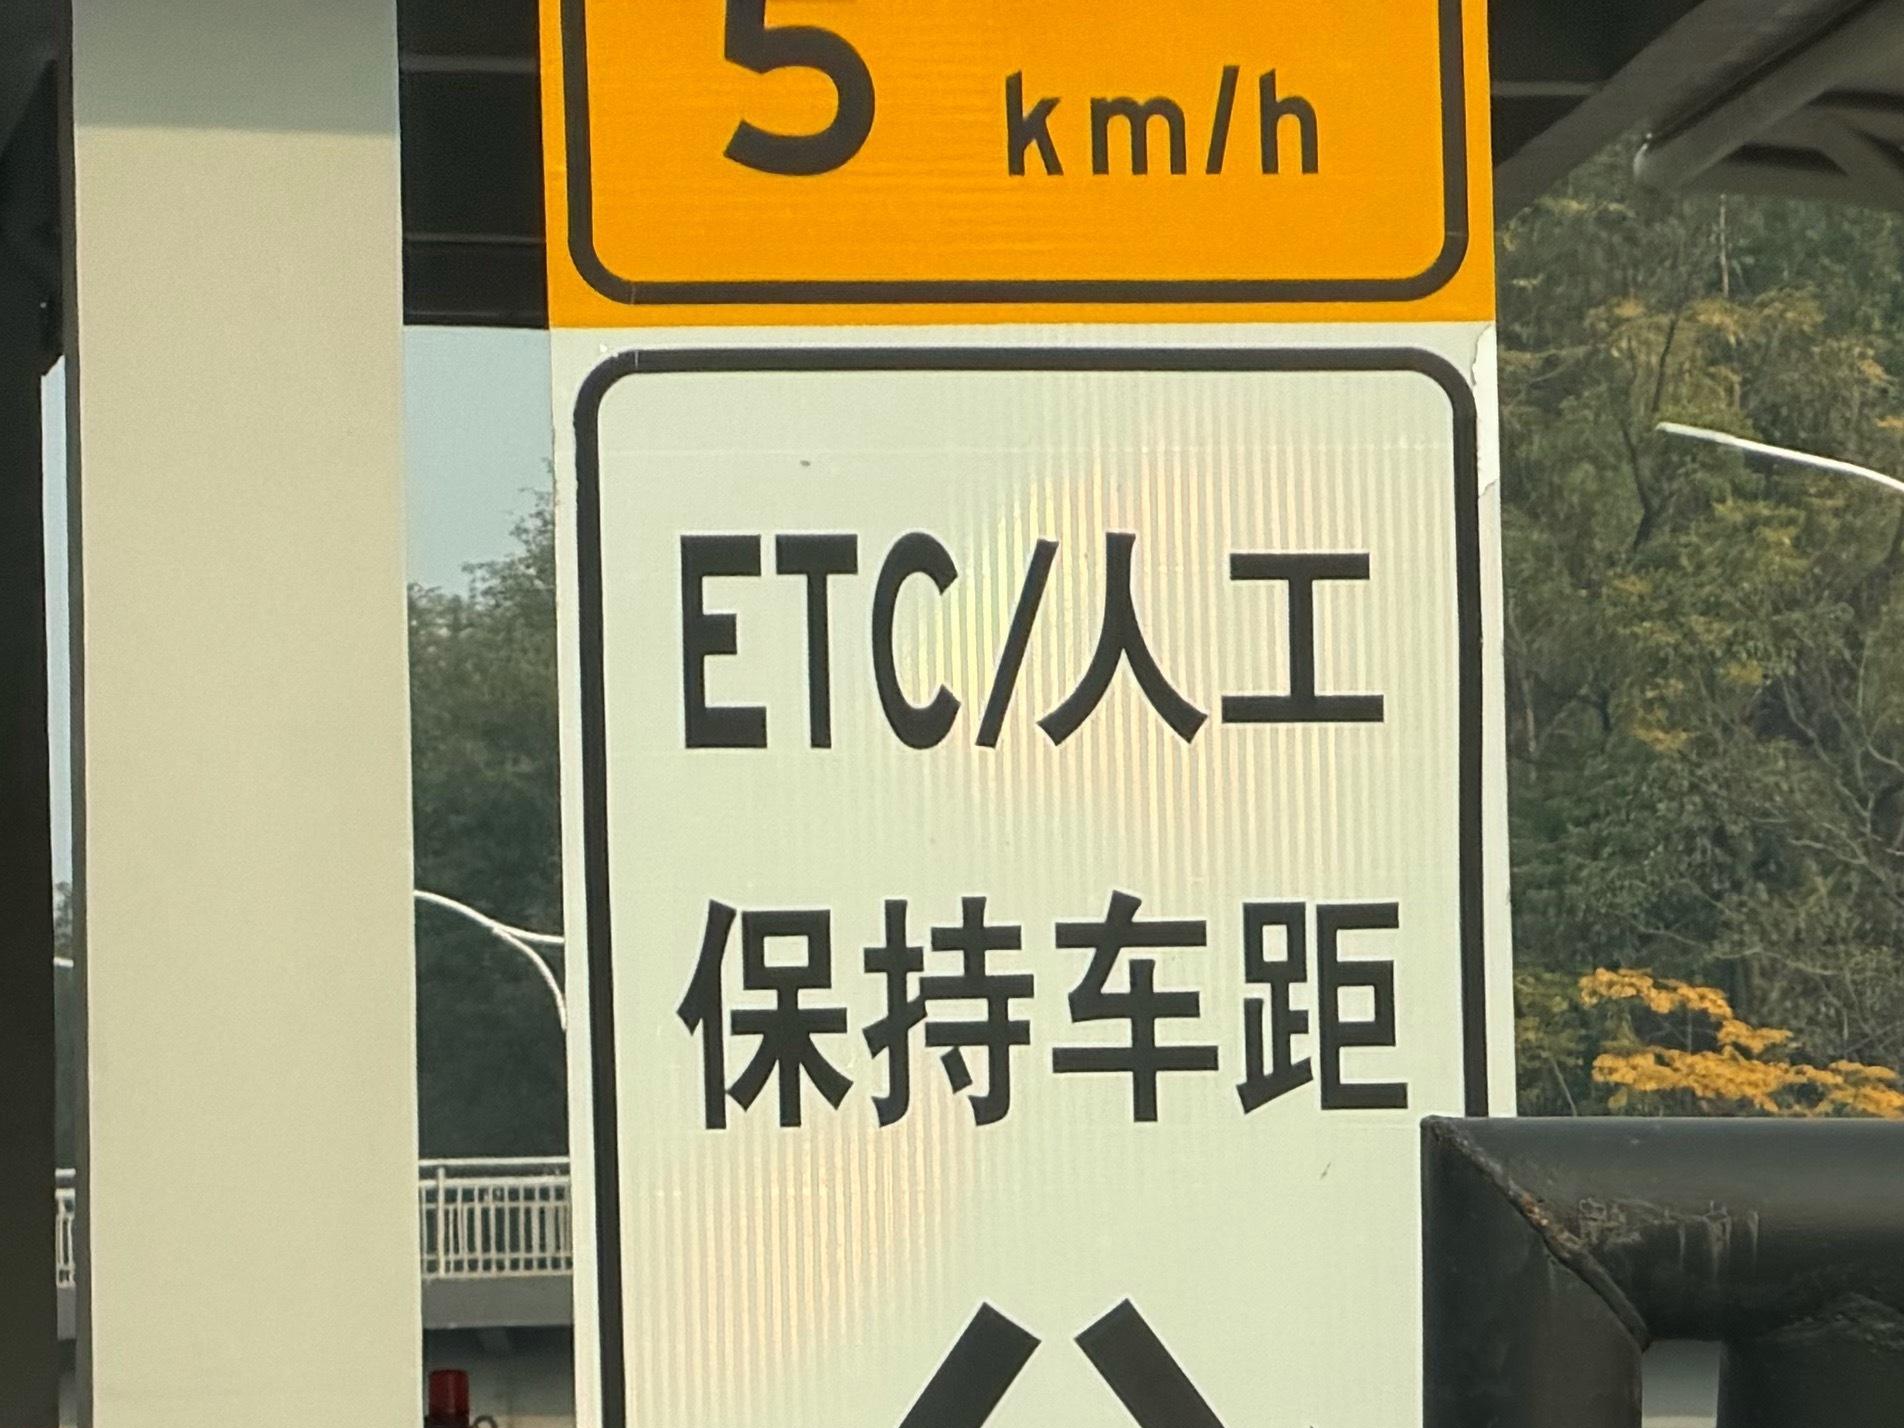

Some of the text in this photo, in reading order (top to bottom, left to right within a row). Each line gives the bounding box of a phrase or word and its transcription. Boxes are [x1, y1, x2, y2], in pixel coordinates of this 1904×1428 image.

[722, 0, 1319, 177] 5 km/h
[679, 531, 1385, 751] ETC/人工
[677, 890, 1409, 1131] 保持车距
